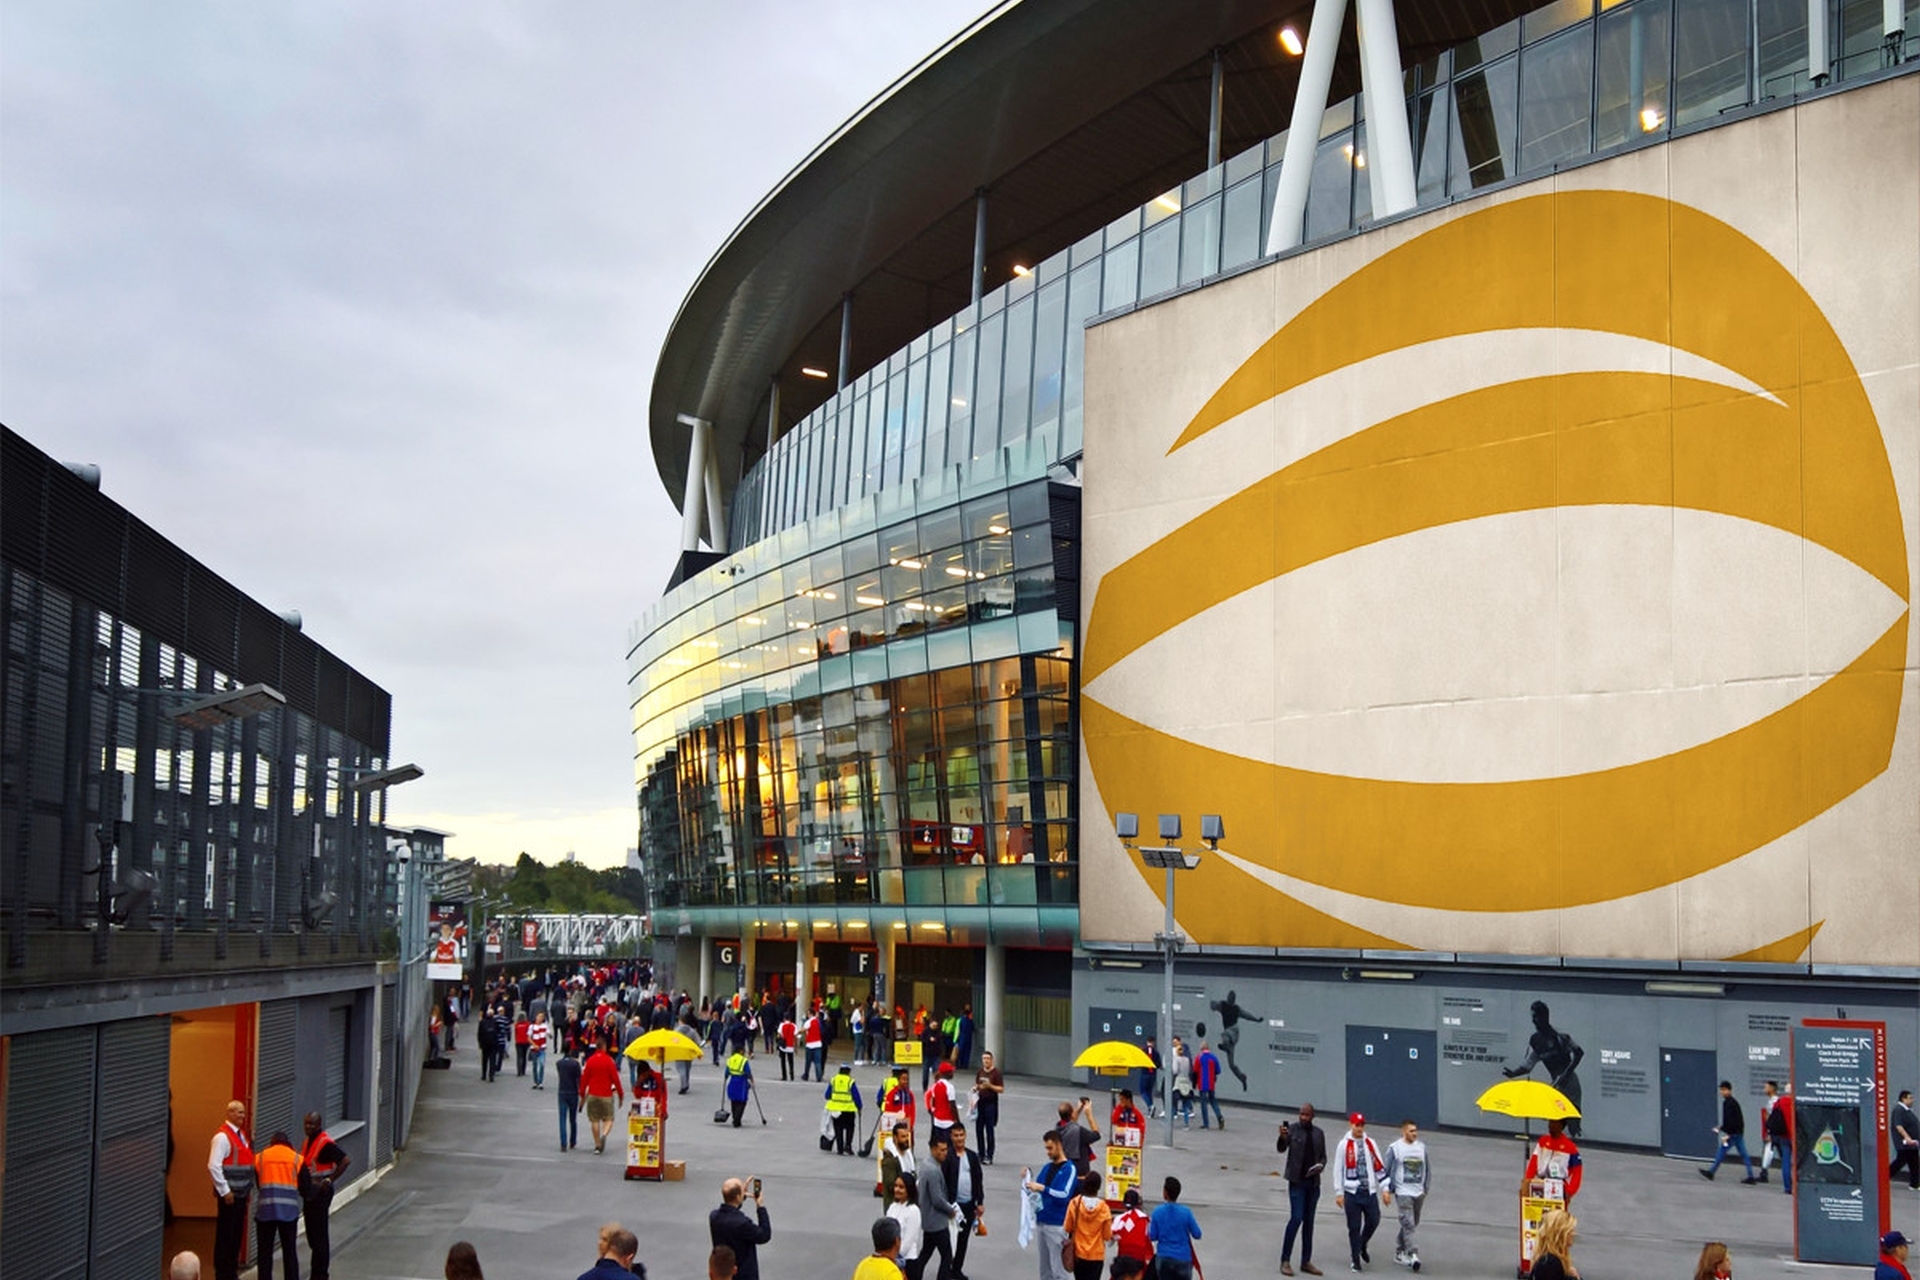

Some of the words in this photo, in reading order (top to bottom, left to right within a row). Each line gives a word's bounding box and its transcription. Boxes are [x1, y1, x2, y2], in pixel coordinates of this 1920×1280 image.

[720, 946, 733, 964] G
[858, 953, 869, 973] F
[1878, 1079, 1886, 1131] EMIRATES
